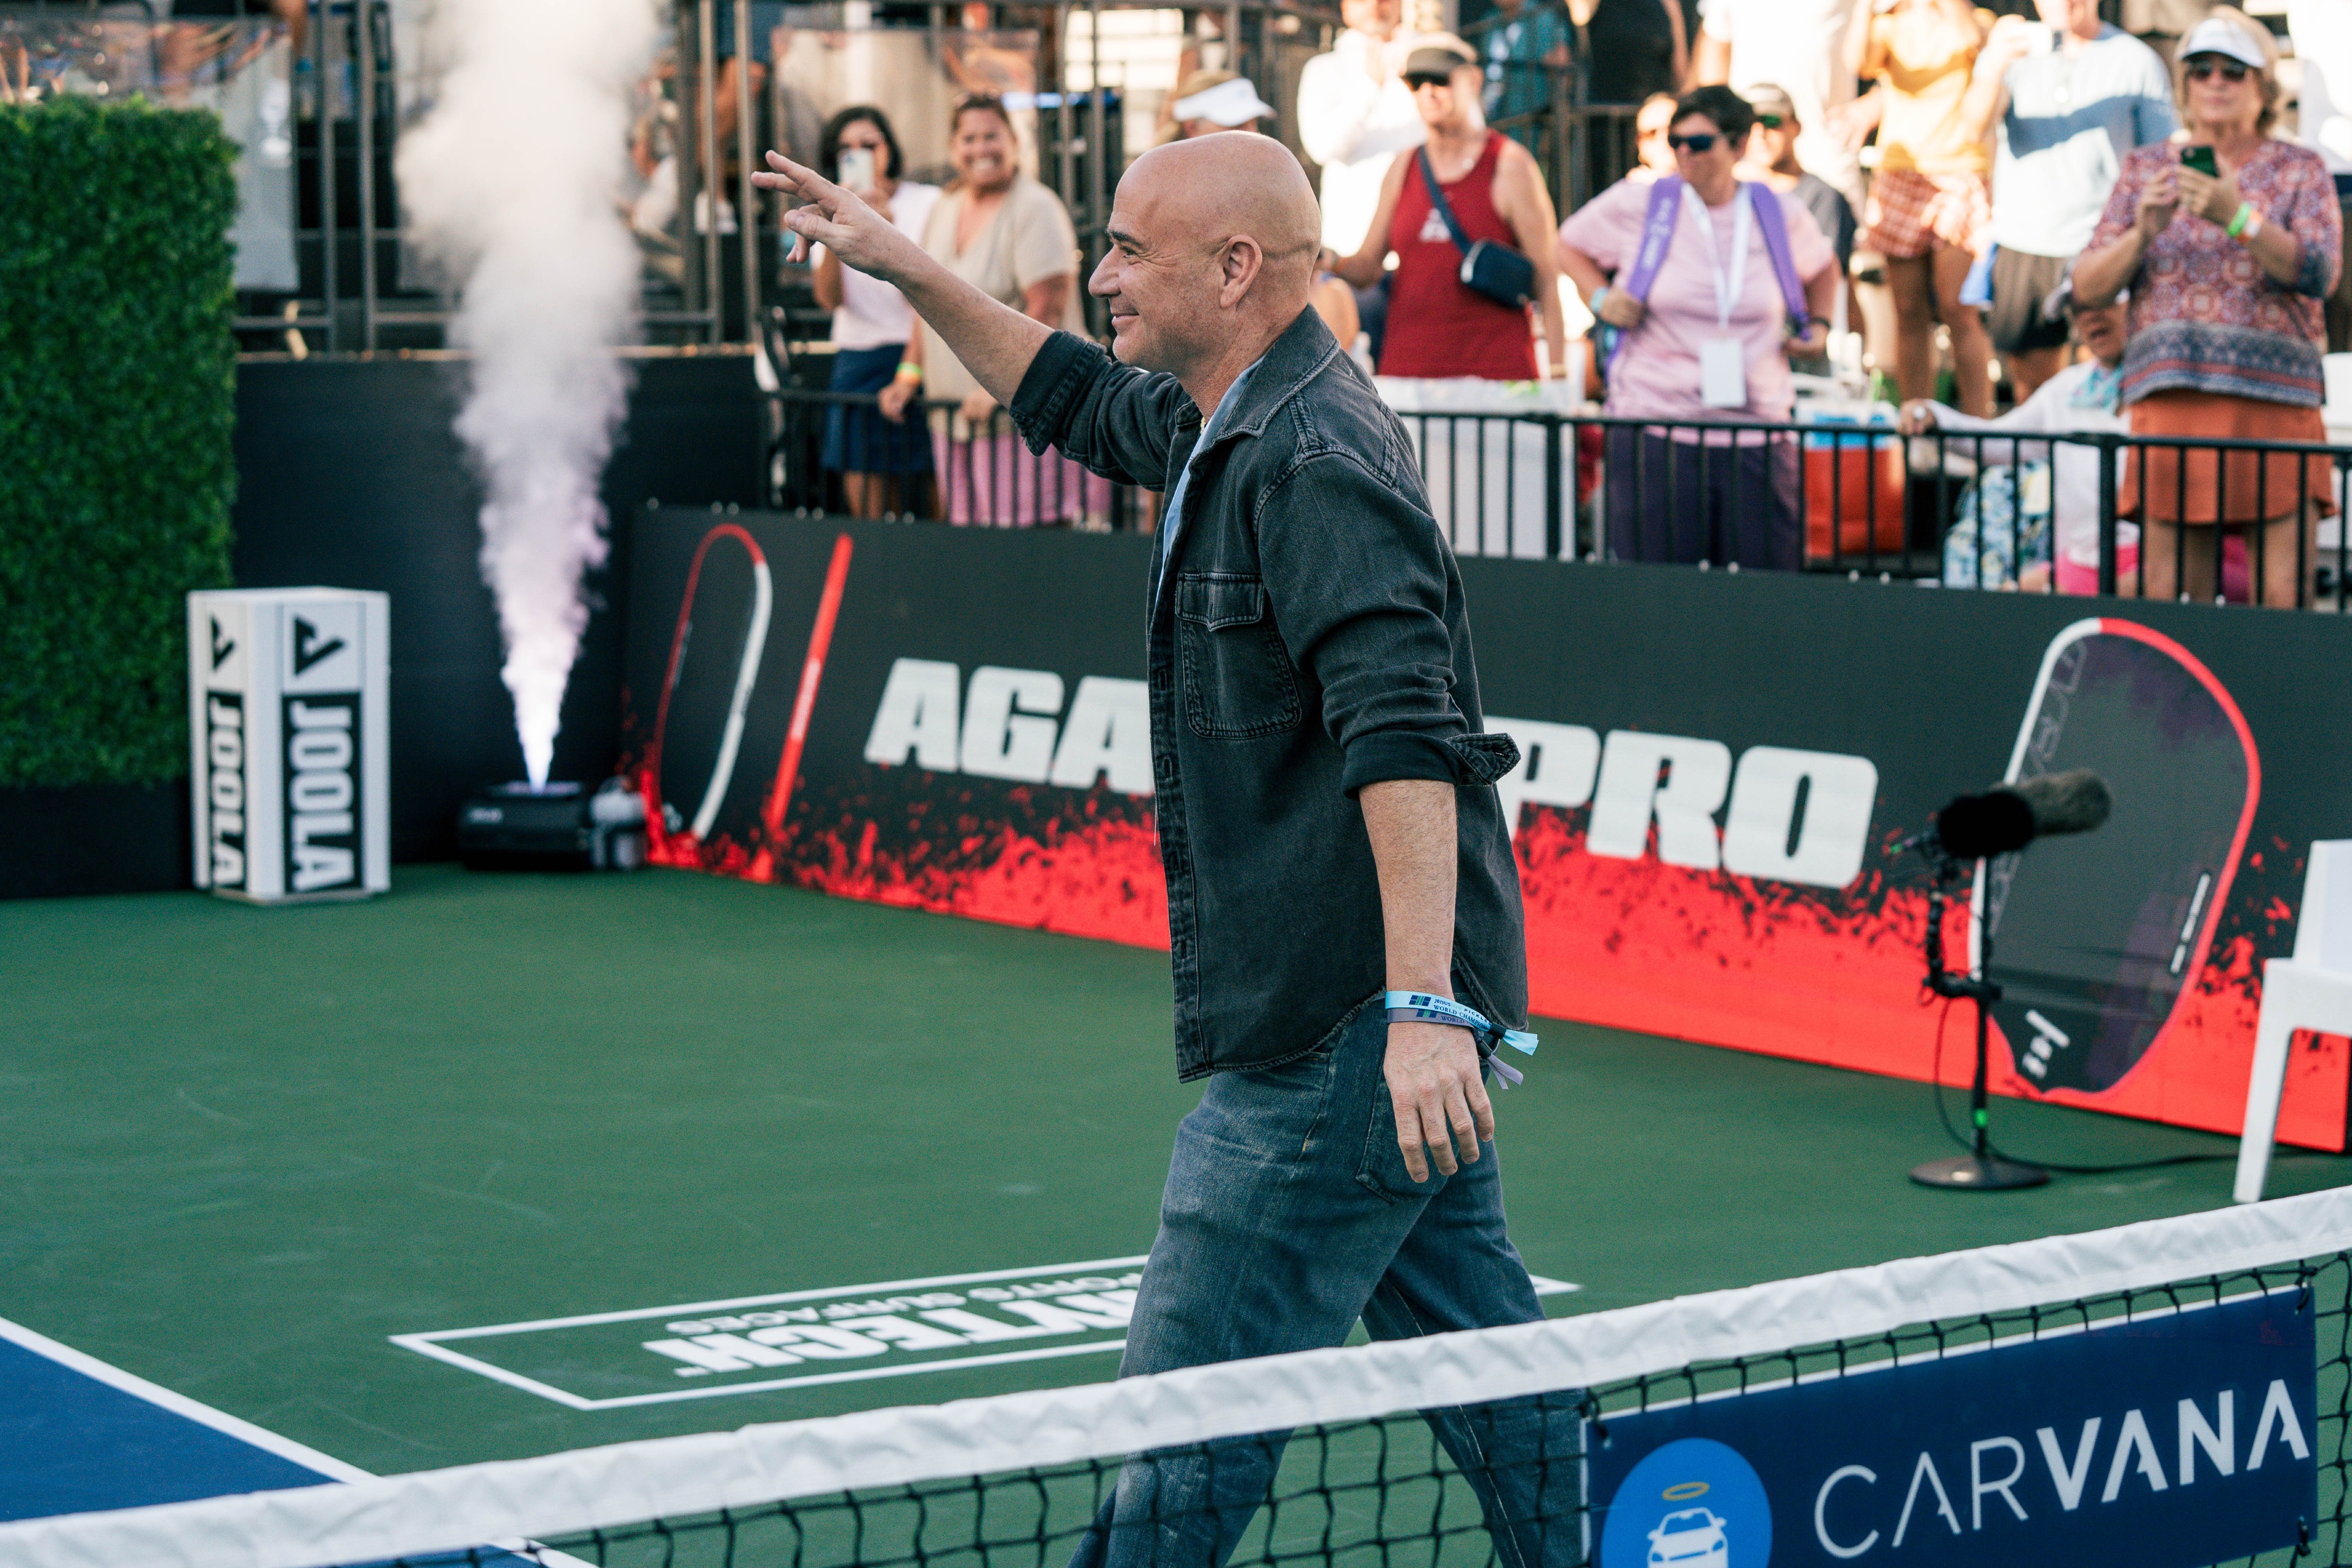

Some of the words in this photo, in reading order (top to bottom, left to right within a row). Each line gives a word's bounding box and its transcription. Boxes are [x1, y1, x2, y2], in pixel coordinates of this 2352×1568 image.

[209, 695, 243, 887] JOOLA
[288, 699, 355, 891] JOOLA
[864, 657, 1154, 795] AGA
[1483, 715, 1878, 889] PRO
[1433, 1004, 1457, 1014] WORLD
[665, 1292, 966, 1334] SURFACES
[1814, 1379, 2310, 1559] CARVANA
